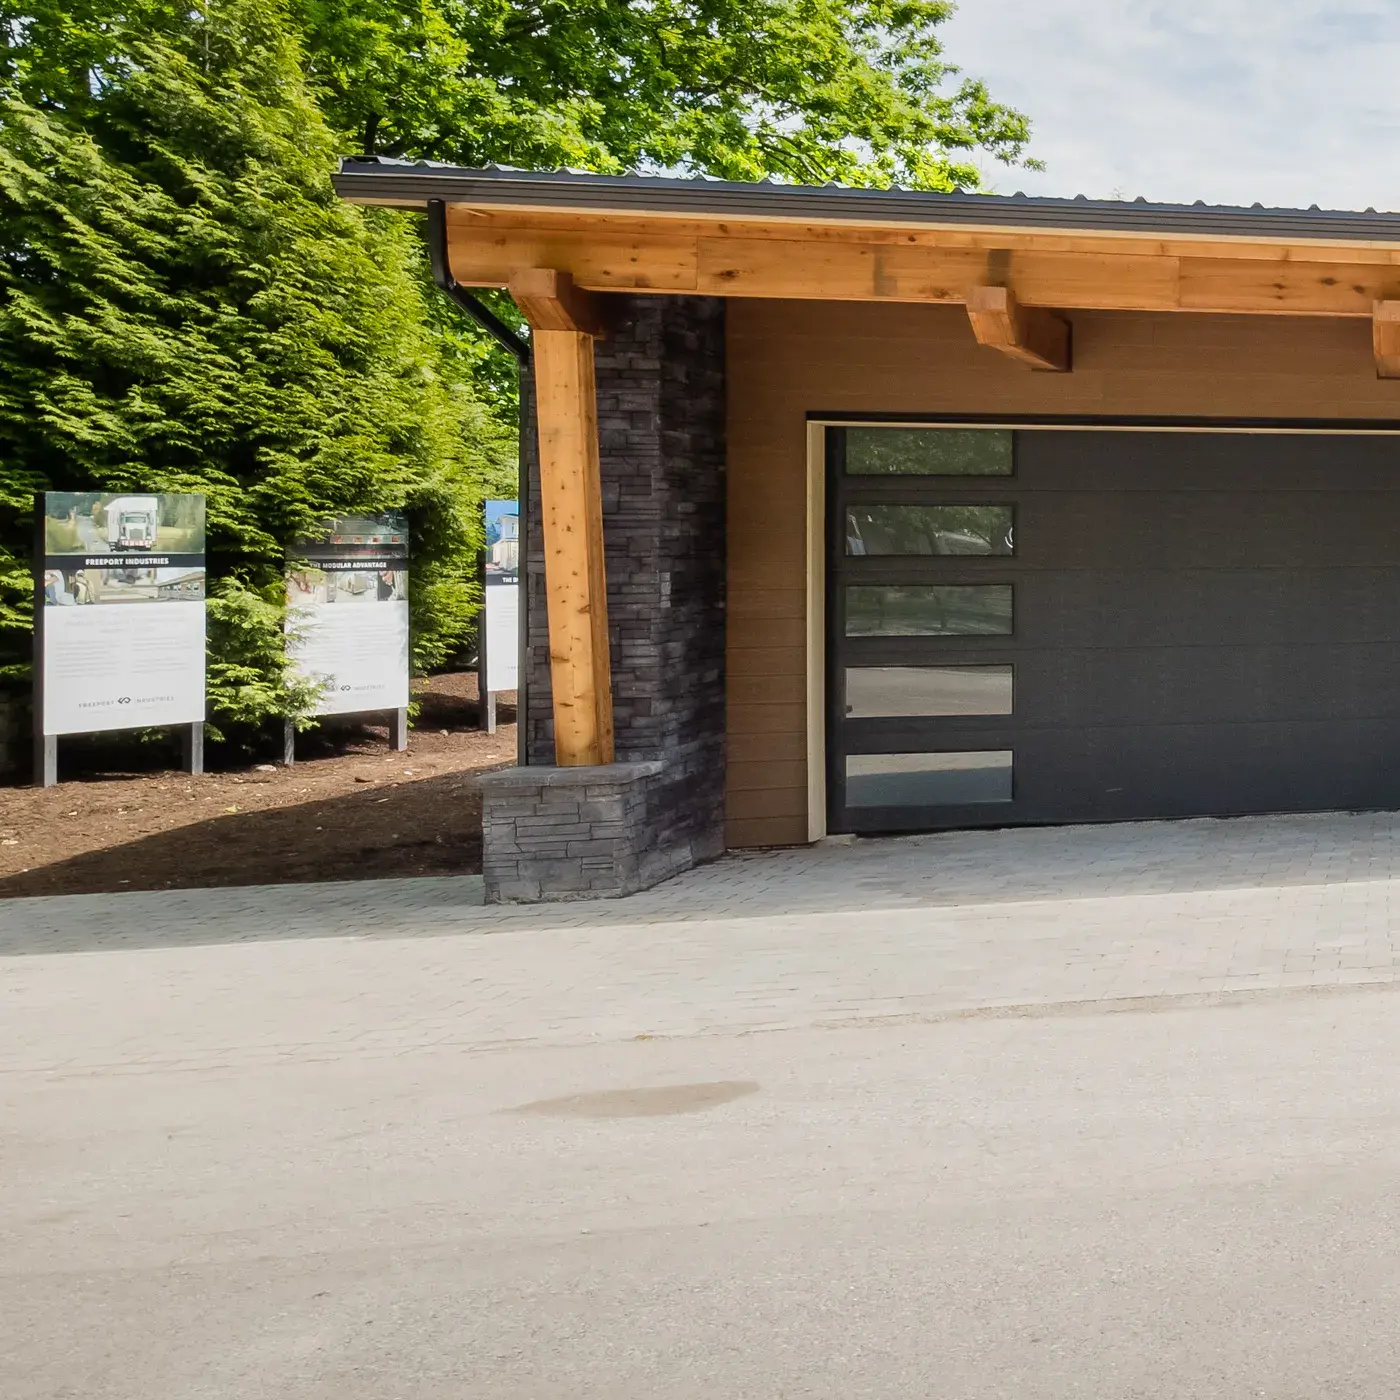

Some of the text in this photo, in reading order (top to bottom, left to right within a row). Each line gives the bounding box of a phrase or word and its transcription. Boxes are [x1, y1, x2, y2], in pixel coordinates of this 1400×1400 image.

[125, 557, 169, 565] INDUSTRIES
[352, 561, 387, 569] ADVANTAGE
[78, 700, 115, 708] FREEPORT
